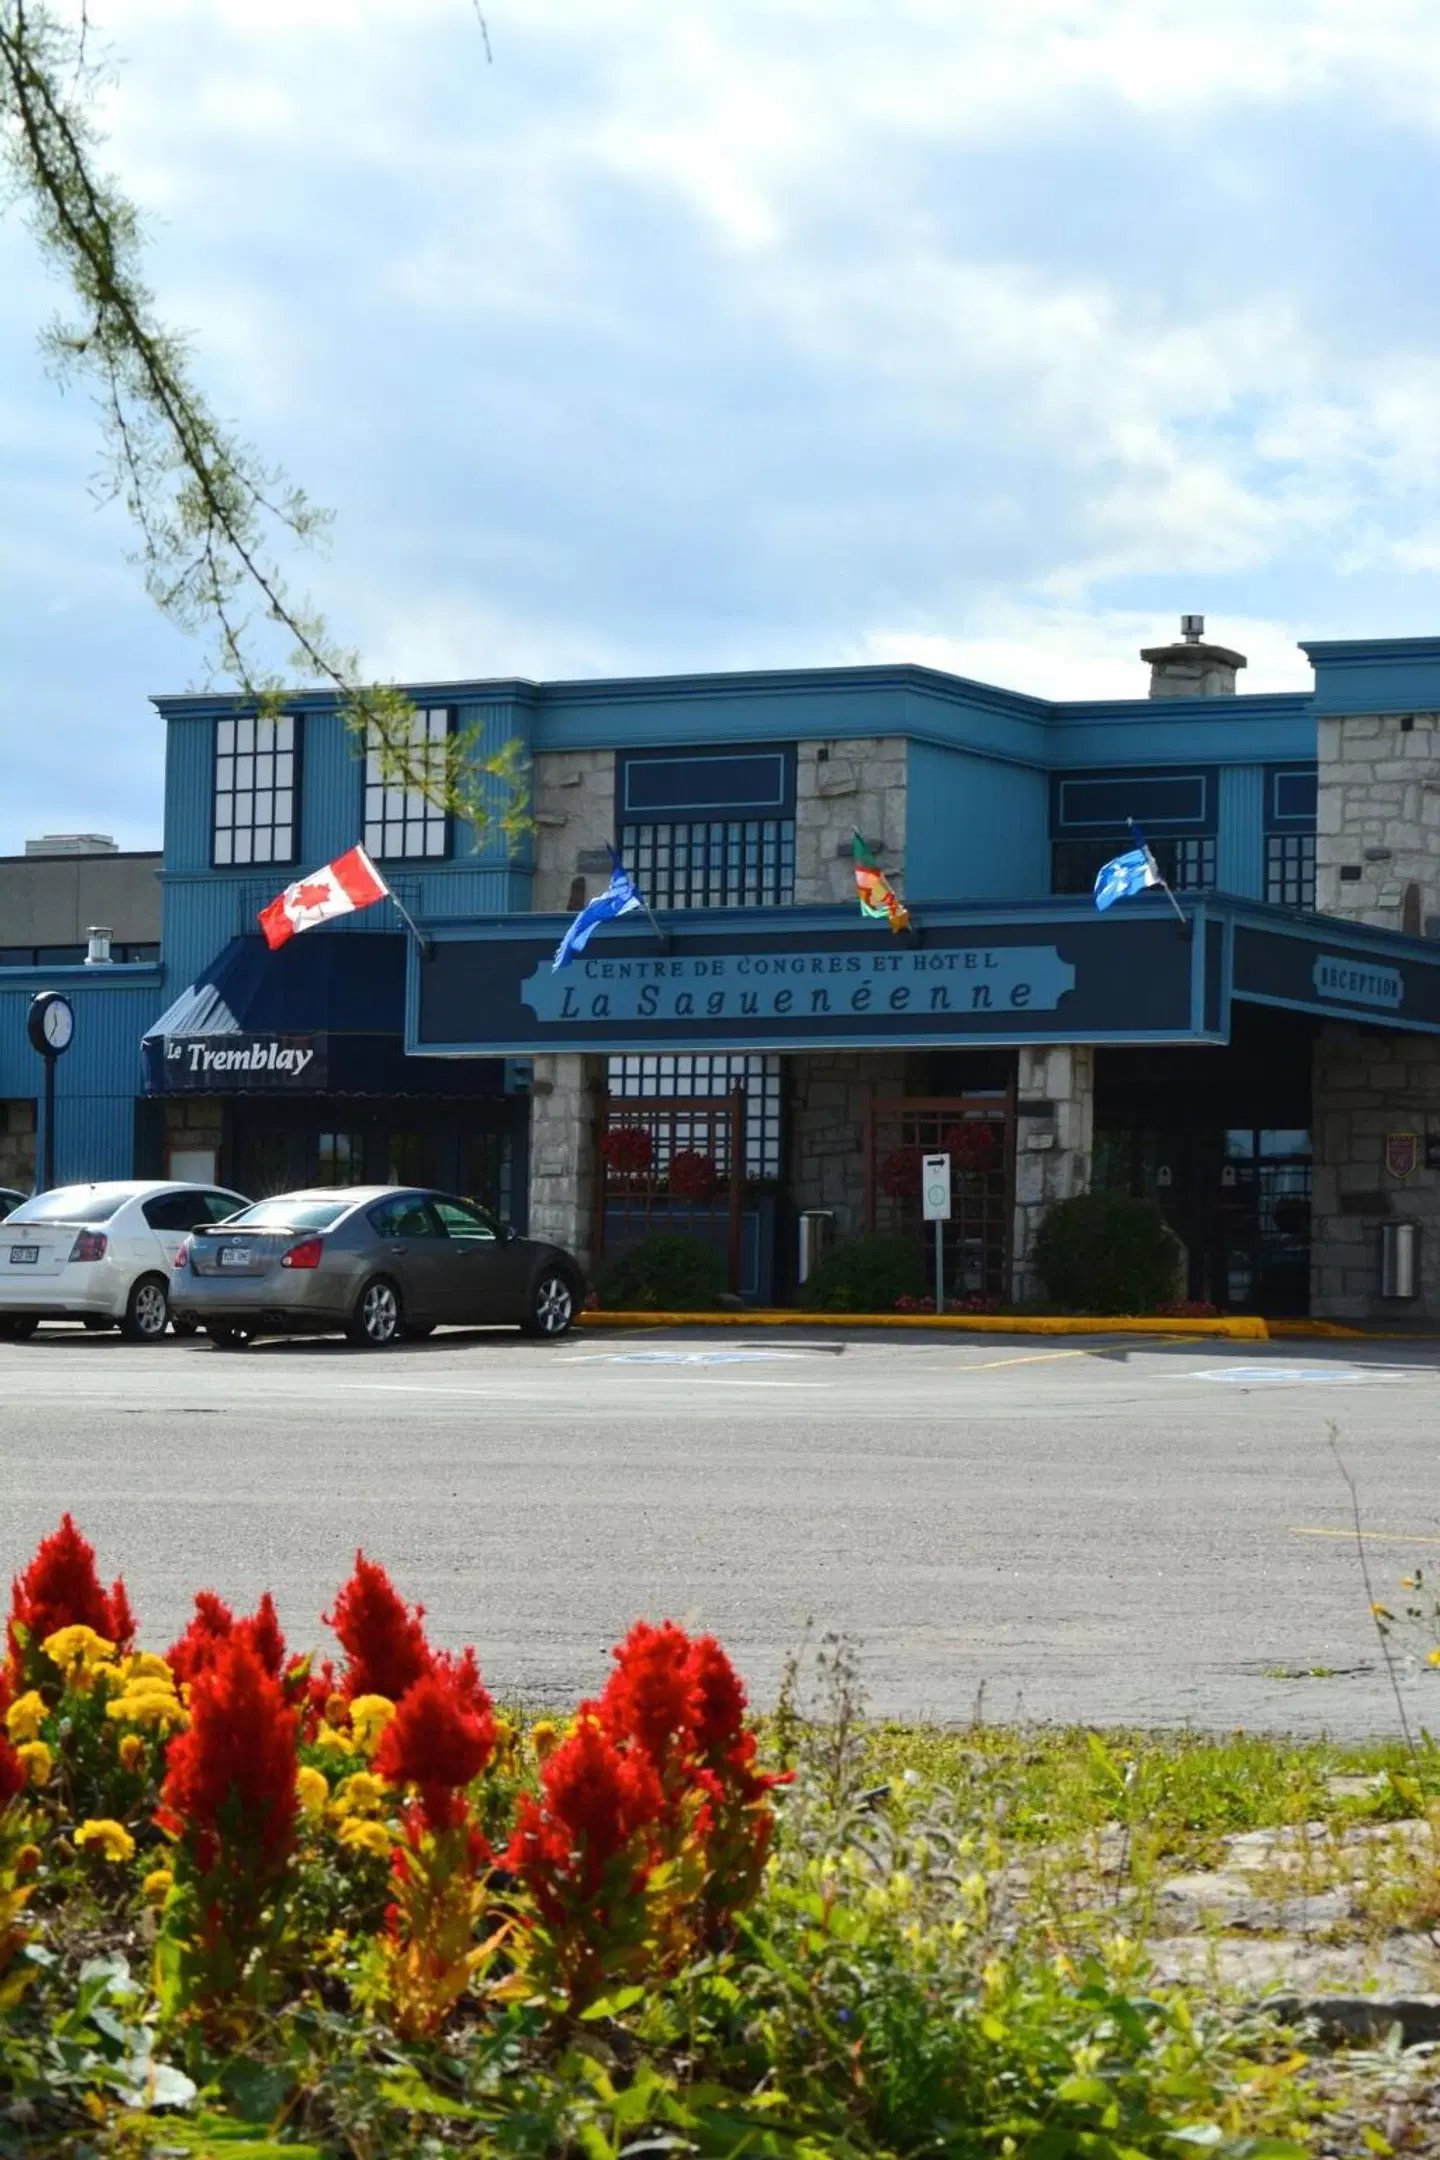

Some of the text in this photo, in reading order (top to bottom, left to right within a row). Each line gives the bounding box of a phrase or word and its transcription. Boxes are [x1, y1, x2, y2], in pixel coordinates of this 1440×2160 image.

[694, 959, 725, 976] DE
[872, 955, 904, 972] ET
[560, 980, 1032, 1018] La Saguenéenne
[167, 1042, 314, 1076] Le Tremblay
